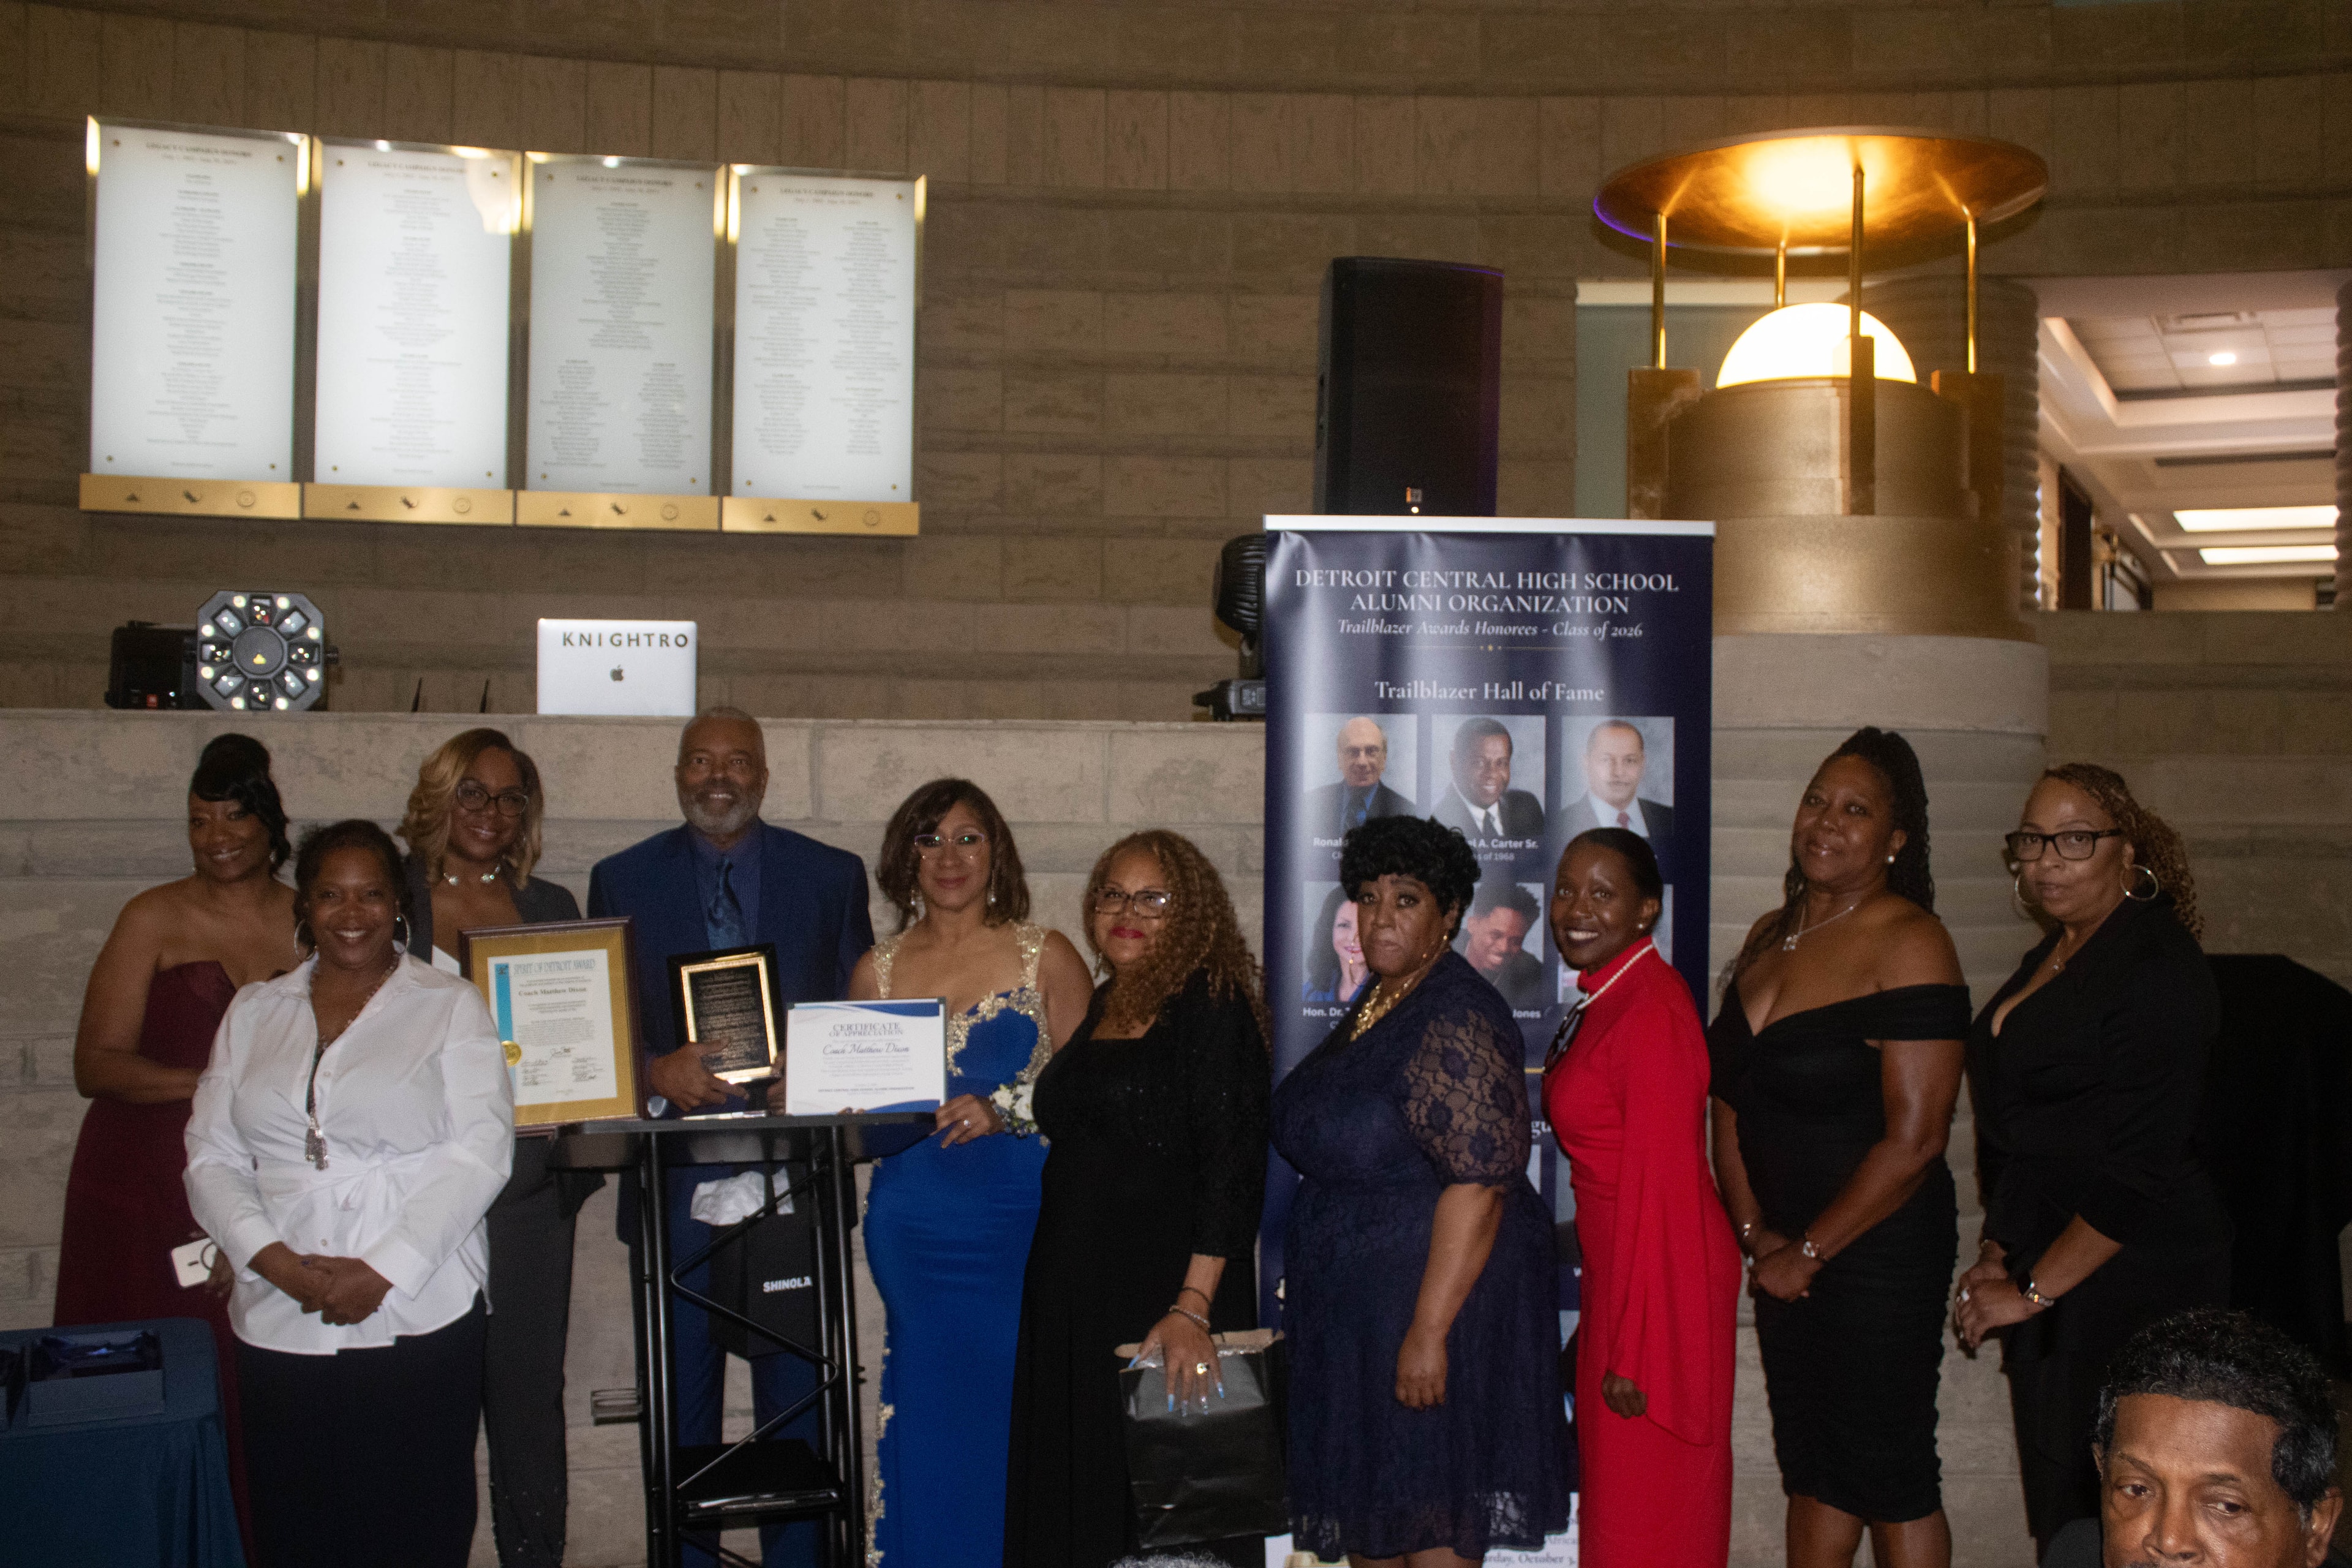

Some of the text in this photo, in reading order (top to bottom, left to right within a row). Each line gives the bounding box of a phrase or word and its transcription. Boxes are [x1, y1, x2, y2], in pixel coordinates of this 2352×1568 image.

[1295, 569, 1678, 592] DETROIT CENTRAL HIGH SCHOOL
[1351, 594, 1629, 614] ALUMNI ORGANIZATION
[1338, 619, 1412, 636] Trailblazer
[1417, 620, 1469, 635] Awards
[1474, 620, 1538, 637] Honorees
[1552, 621, 1589, 638] Class
[1594, 621, 1609, 640] of
[1611, 625, 1643, 638] 2026
[563, 631, 688, 647] KNIGHTRO
[1375, 681, 1604, 701] Trailblazer Hall of Fame
[1491, 839, 1524, 849] Carter
[543, 960, 571, 973] DETROIT
[1303, 1007, 1327, 1017] Hon.
[1513, 1009, 1541, 1019] Jones
[833, 1022, 900, 1031] CERTIFICATE
[846, 1042, 884, 1054] Matthew
[763, 1276, 812, 1292] SHINOLA
[1519, 1553, 1564, 1563] October
